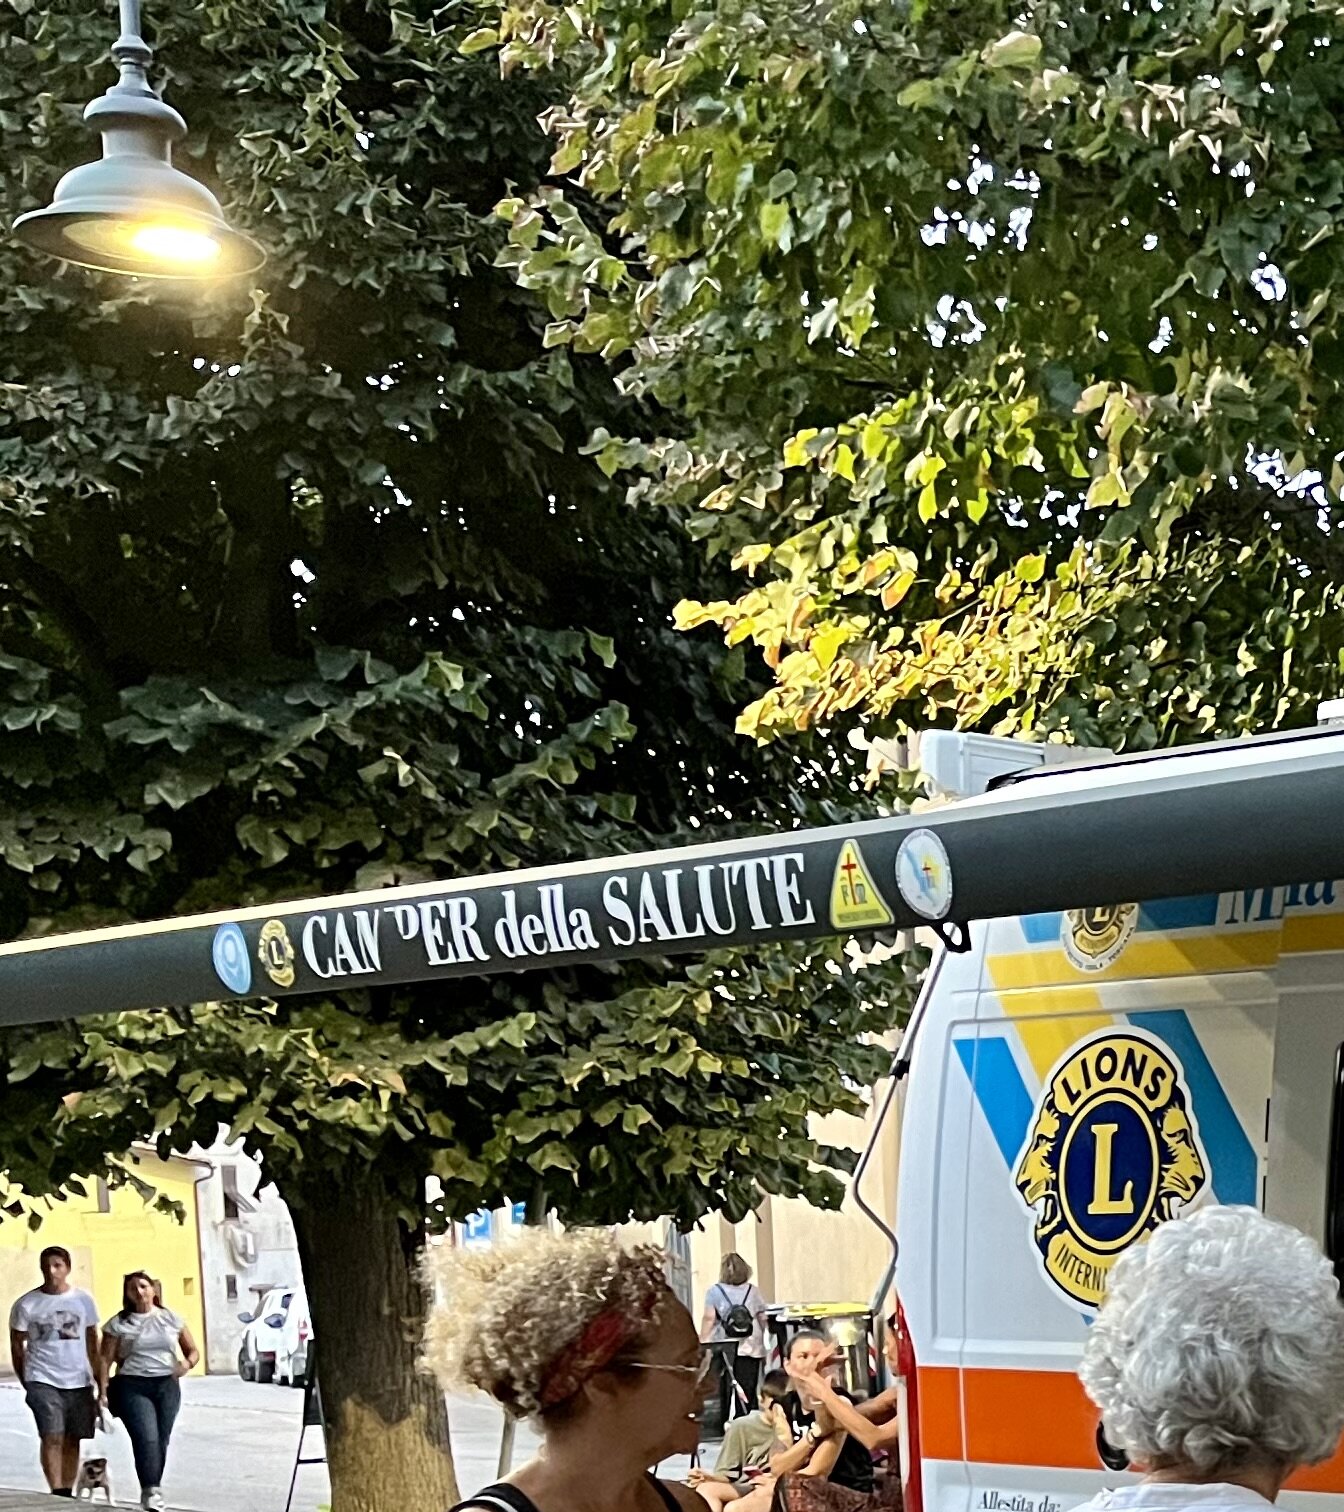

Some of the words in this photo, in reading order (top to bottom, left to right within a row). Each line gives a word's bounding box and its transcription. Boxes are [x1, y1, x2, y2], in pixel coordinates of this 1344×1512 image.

[494, 883, 600, 960] della
[602, 852, 816, 947] SALUTE
[1060, 1047, 1167, 1107] LIONS
[1087, 1123, 1136, 1215] L
[1054, 1243, 1108, 1292] INTERN
